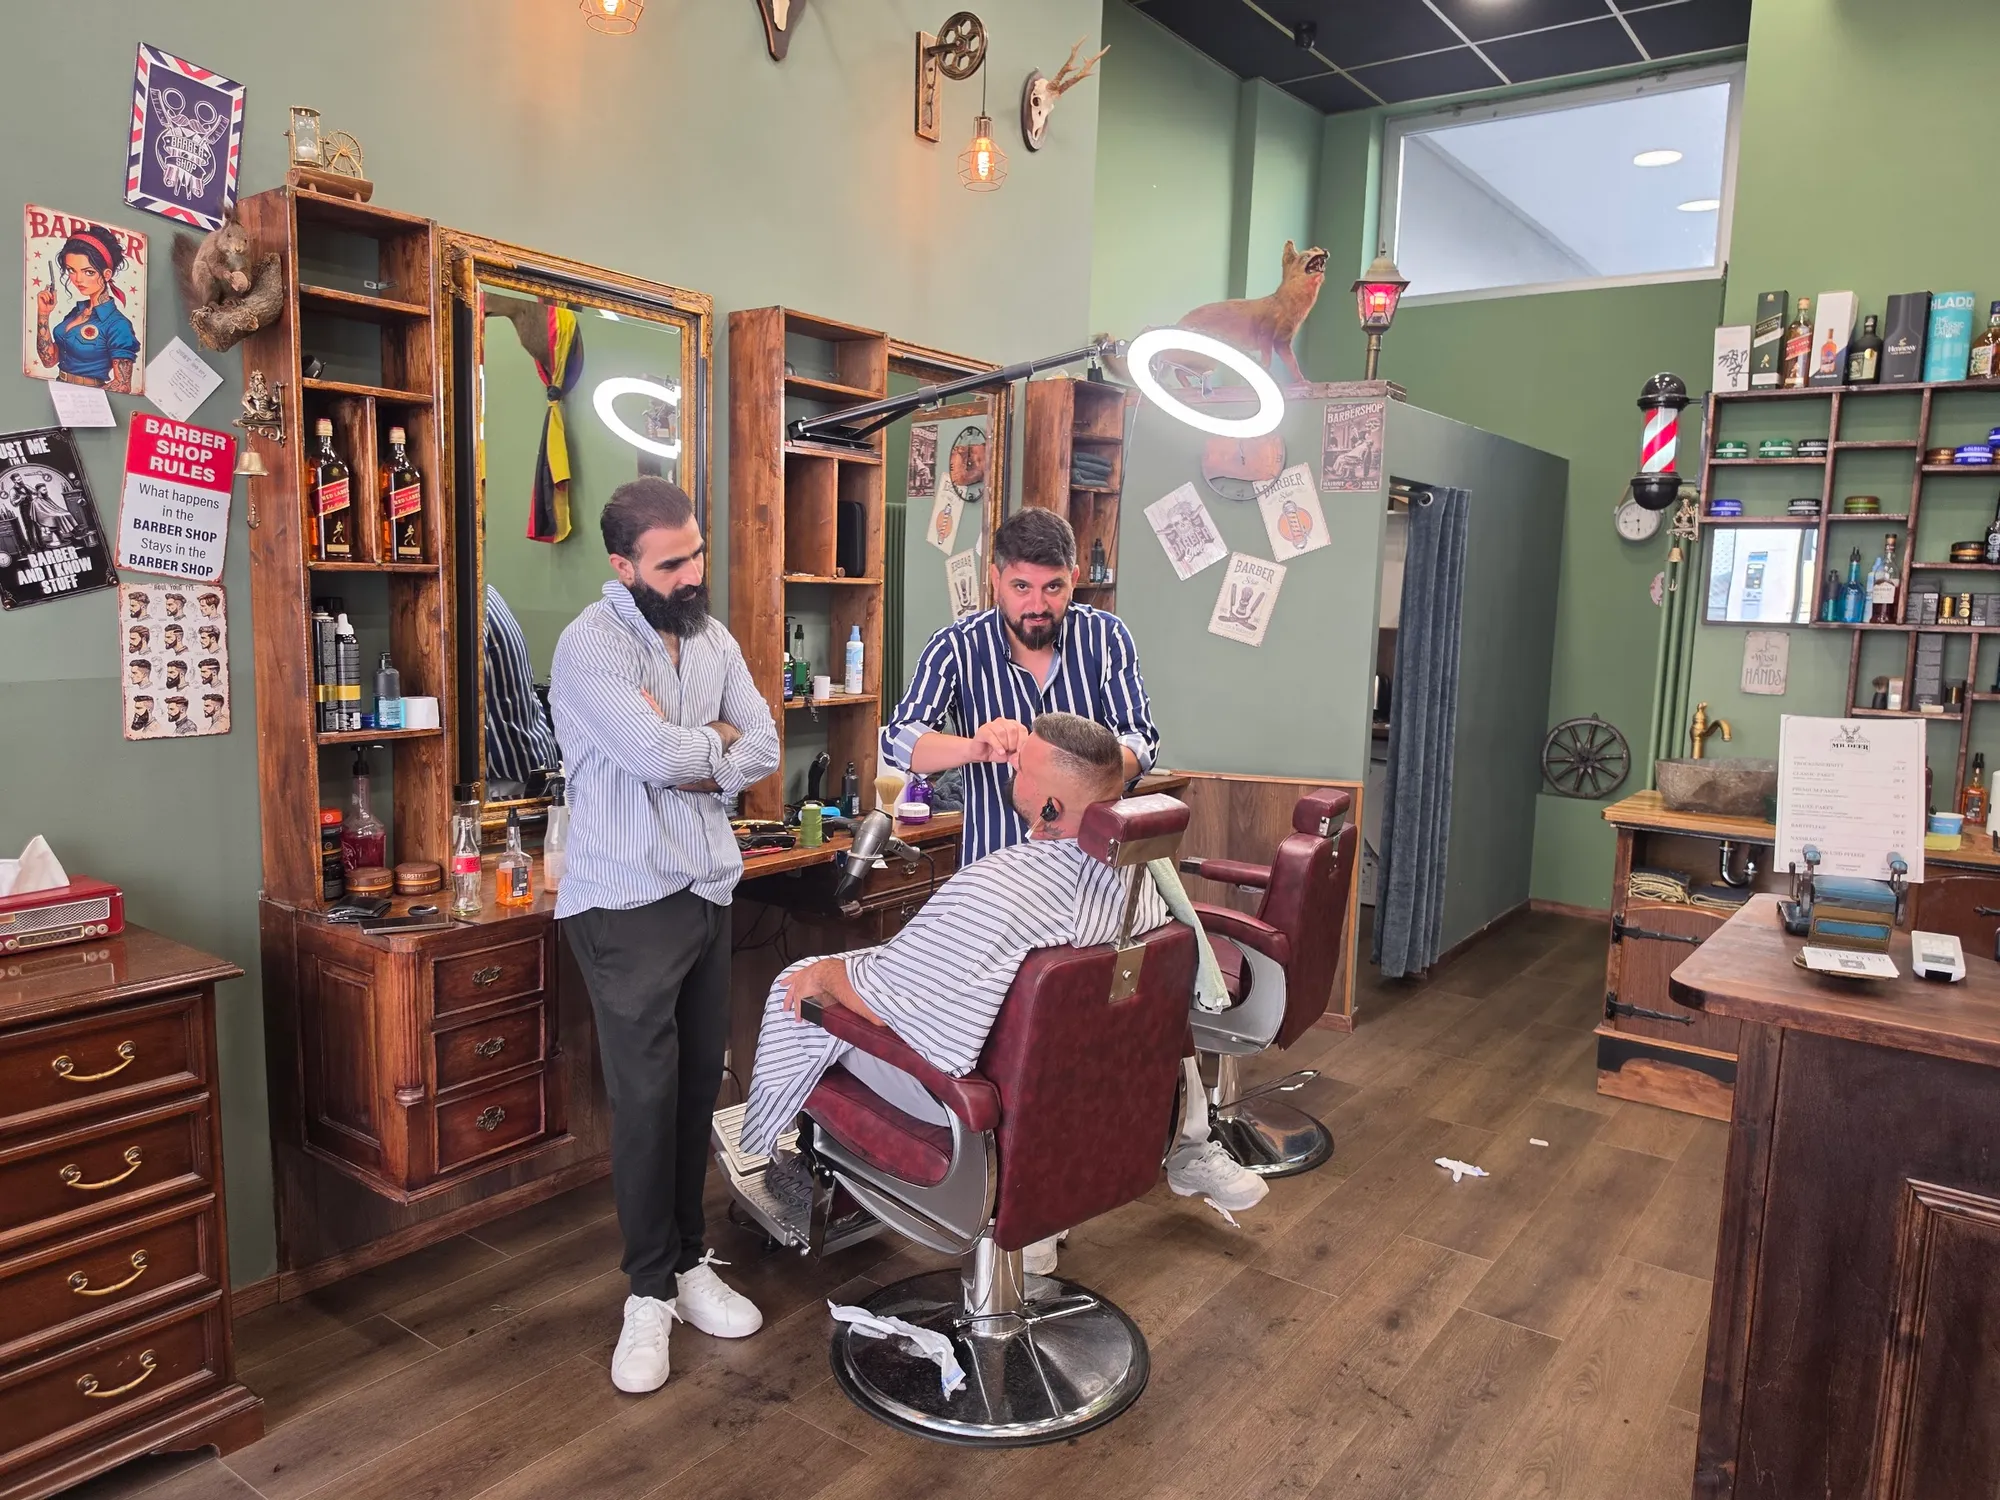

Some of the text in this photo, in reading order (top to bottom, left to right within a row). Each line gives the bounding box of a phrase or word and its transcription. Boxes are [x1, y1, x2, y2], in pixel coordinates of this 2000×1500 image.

[171, 136, 204, 158] BARBER
[175, 158, 197, 173] SHOP
[30, 211, 144, 265] BARER
[1327, 403, 1384, 424] BARBERSHOP
[145, 418, 227, 451] BARBER
[25, 437, 51, 456] ME
[156, 440, 213, 464] SHOP
[22, 456, 29, 464] A
[149, 456, 216, 483] RULES
[139, 482, 220, 510] What happens
[1261, 472, 1305, 500] BARBER
[162, 505, 194, 521] in the
[133, 518, 218, 543] BARBER SHOP
[27, 546, 79, 568] BARBER
[140, 538, 207, 559] Stays in the
[17, 556, 93, 586] AND I KNOW
[129, 553, 214, 577] BARBER SHOP
[1234, 559, 1275, 584] BARBER
[41, 574, 78, 595] STUFF
[1744, 668, 1783, 686] HANDS
